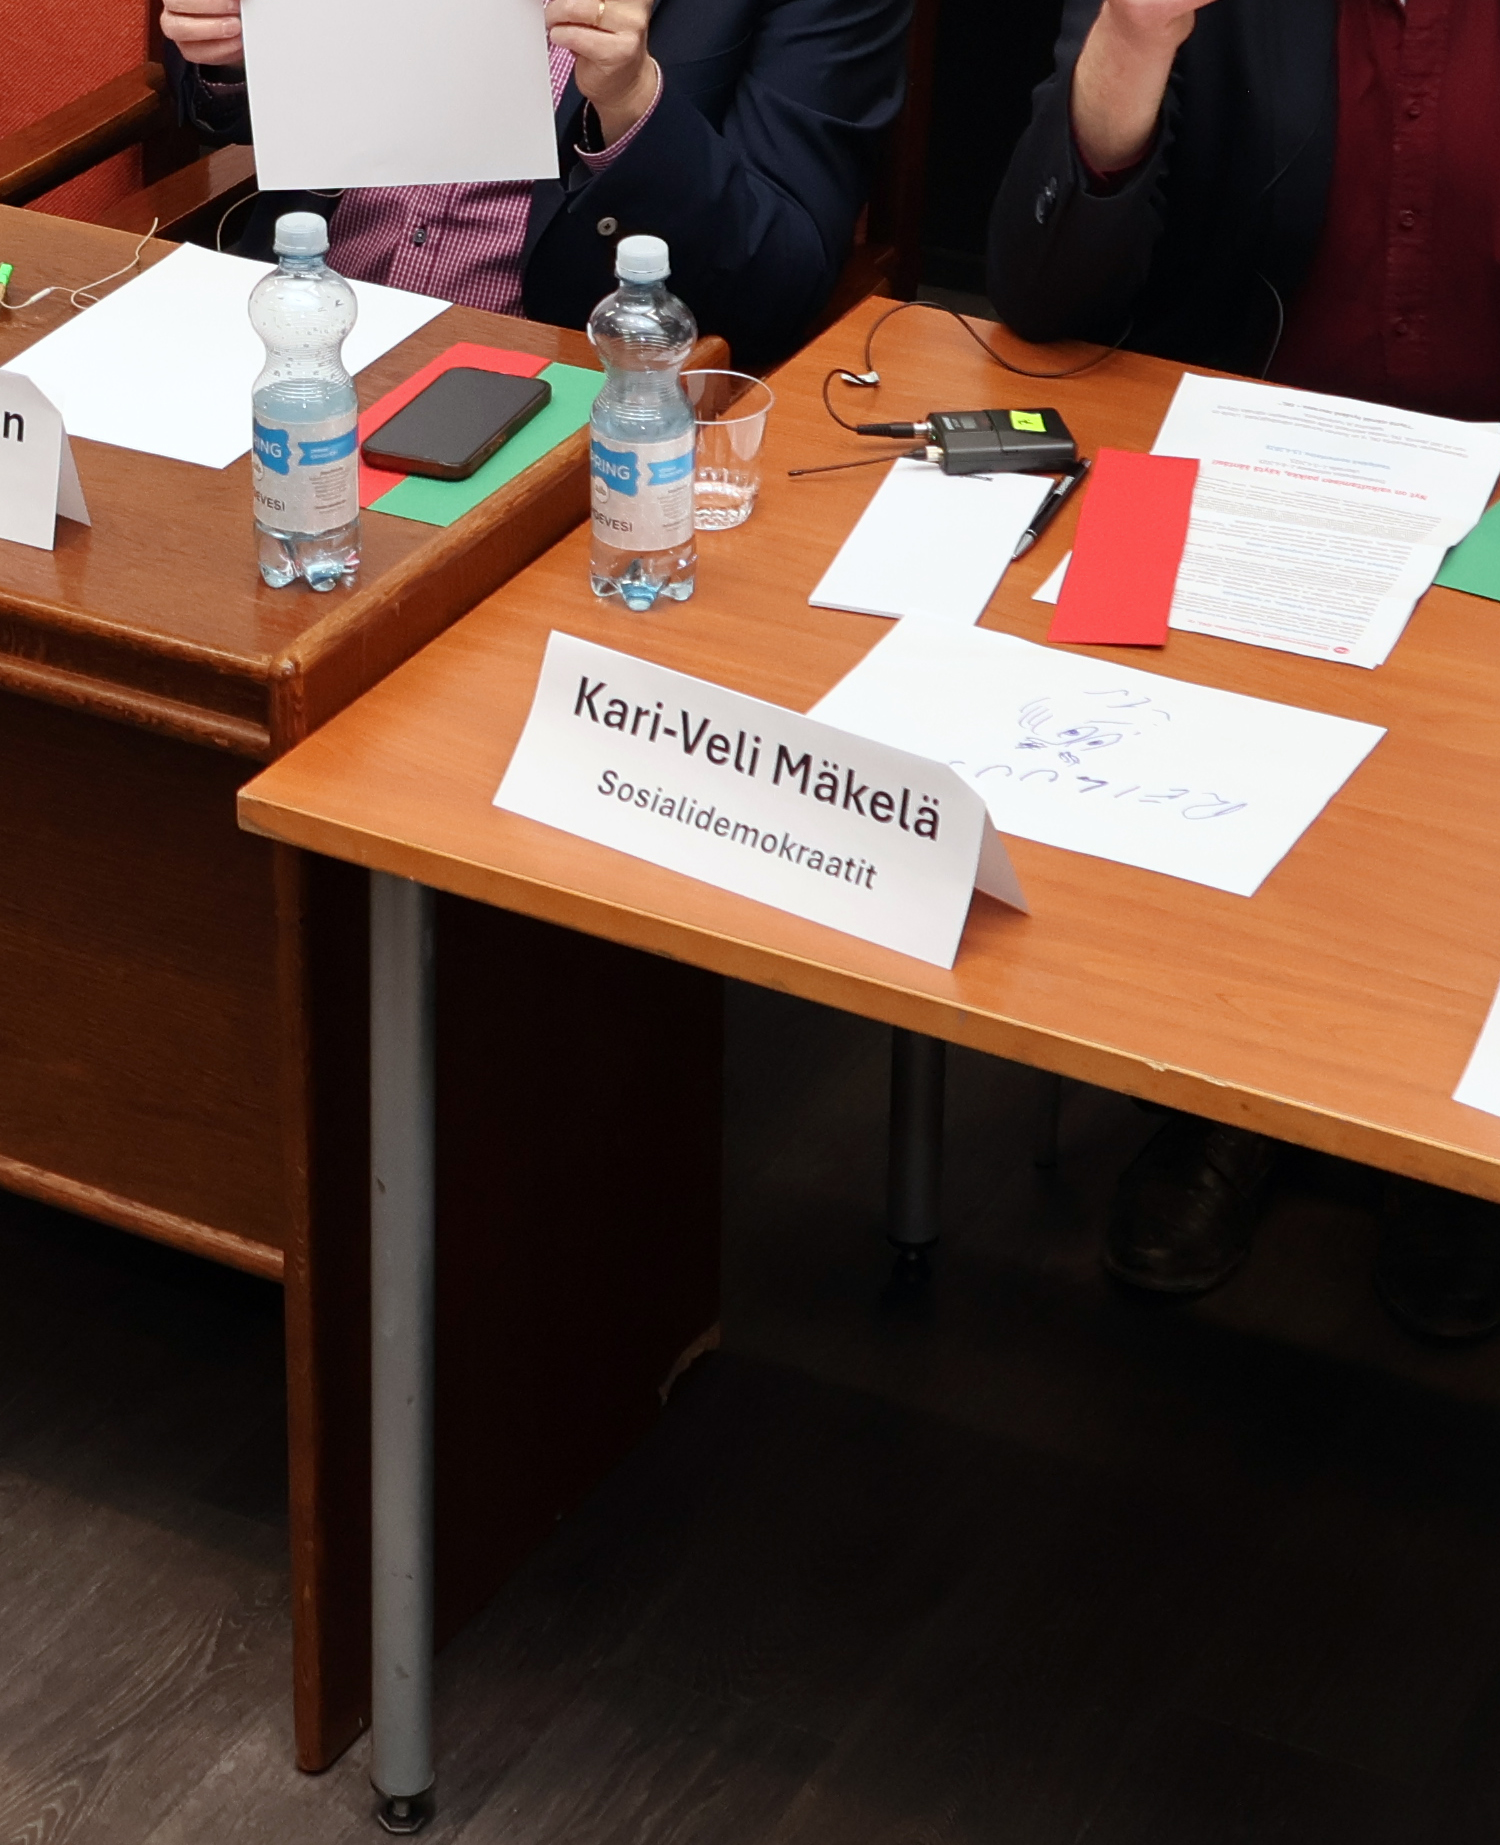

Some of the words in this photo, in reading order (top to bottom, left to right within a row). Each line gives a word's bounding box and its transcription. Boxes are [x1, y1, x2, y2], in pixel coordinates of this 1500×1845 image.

[573, 675, 762, 778] Kari-Veli
[771, 743, 940, 842] Mäkelä
[597, 769, 878, 891] Sosialidemokraatit
